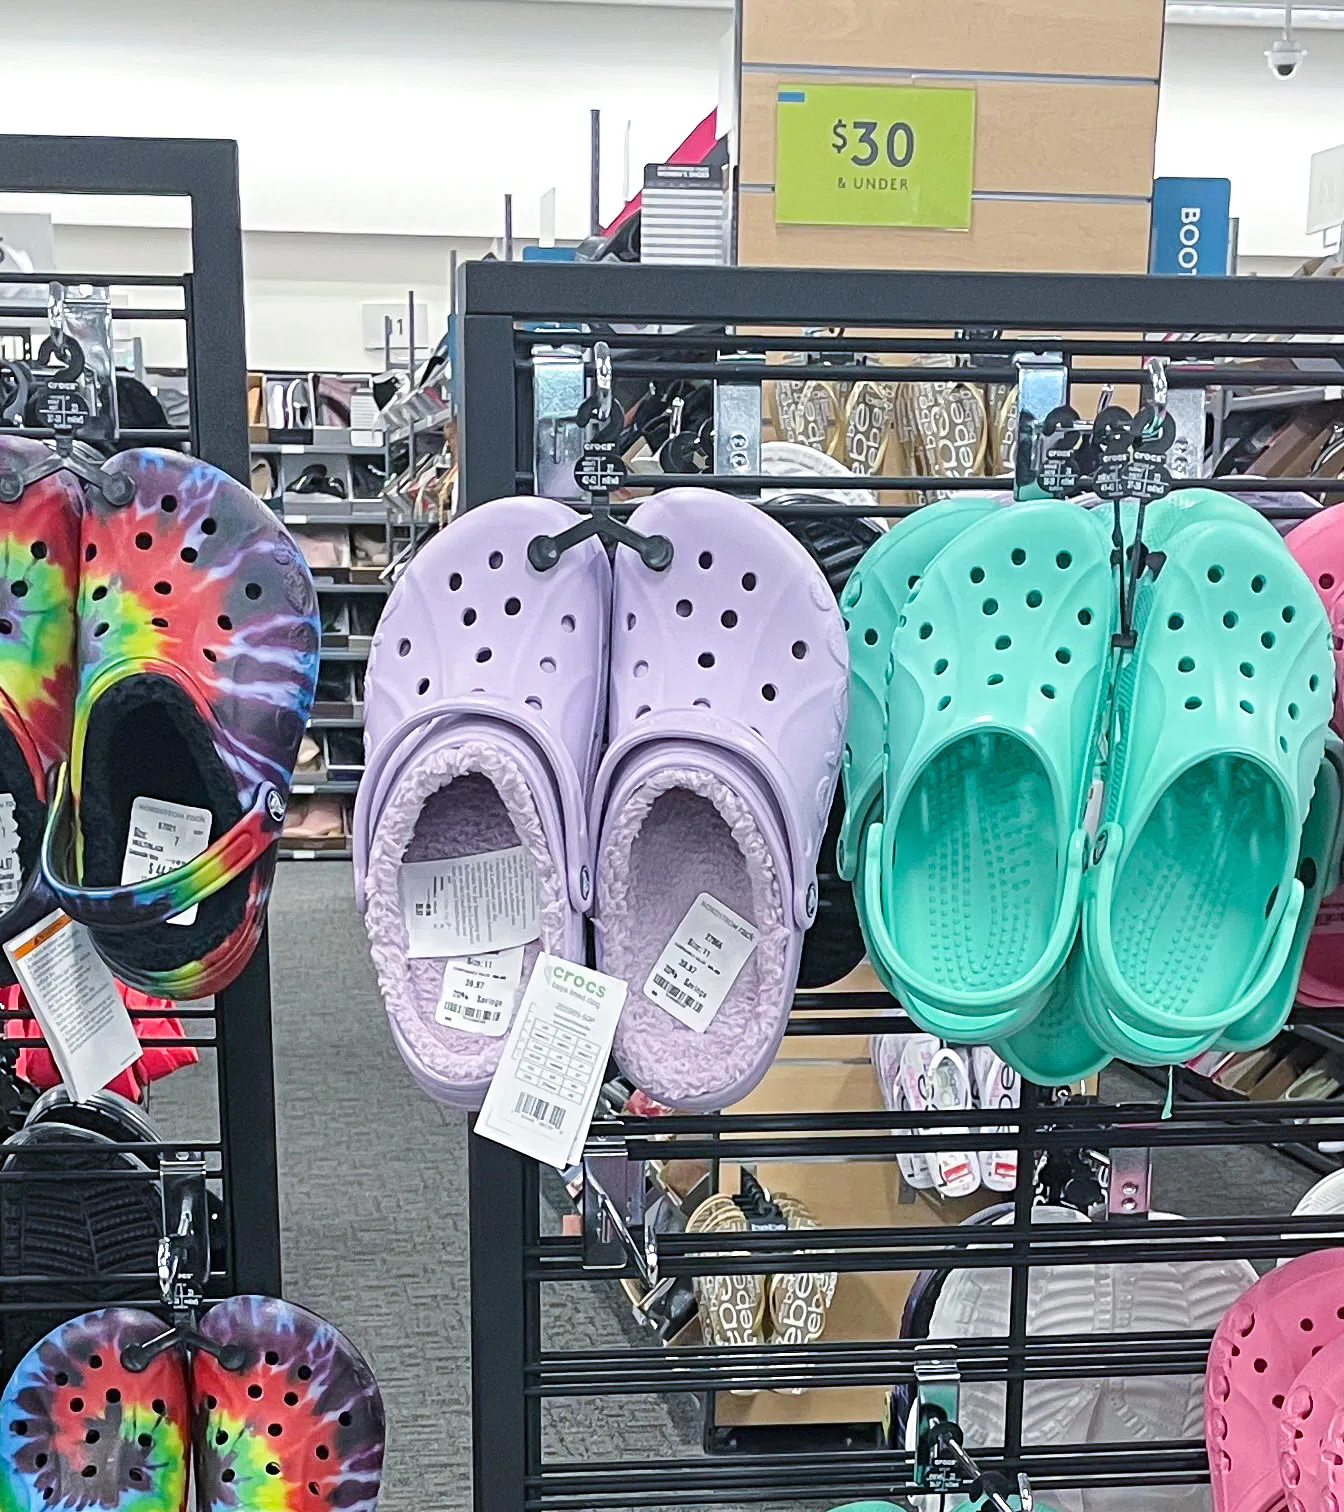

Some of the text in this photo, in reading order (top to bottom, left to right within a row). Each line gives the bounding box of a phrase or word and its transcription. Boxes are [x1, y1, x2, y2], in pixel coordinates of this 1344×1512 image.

[831, 119, 914, 168] $30
[837, 177, 908, 191] & UNDER
[552, 966, 607, 998] crocs
